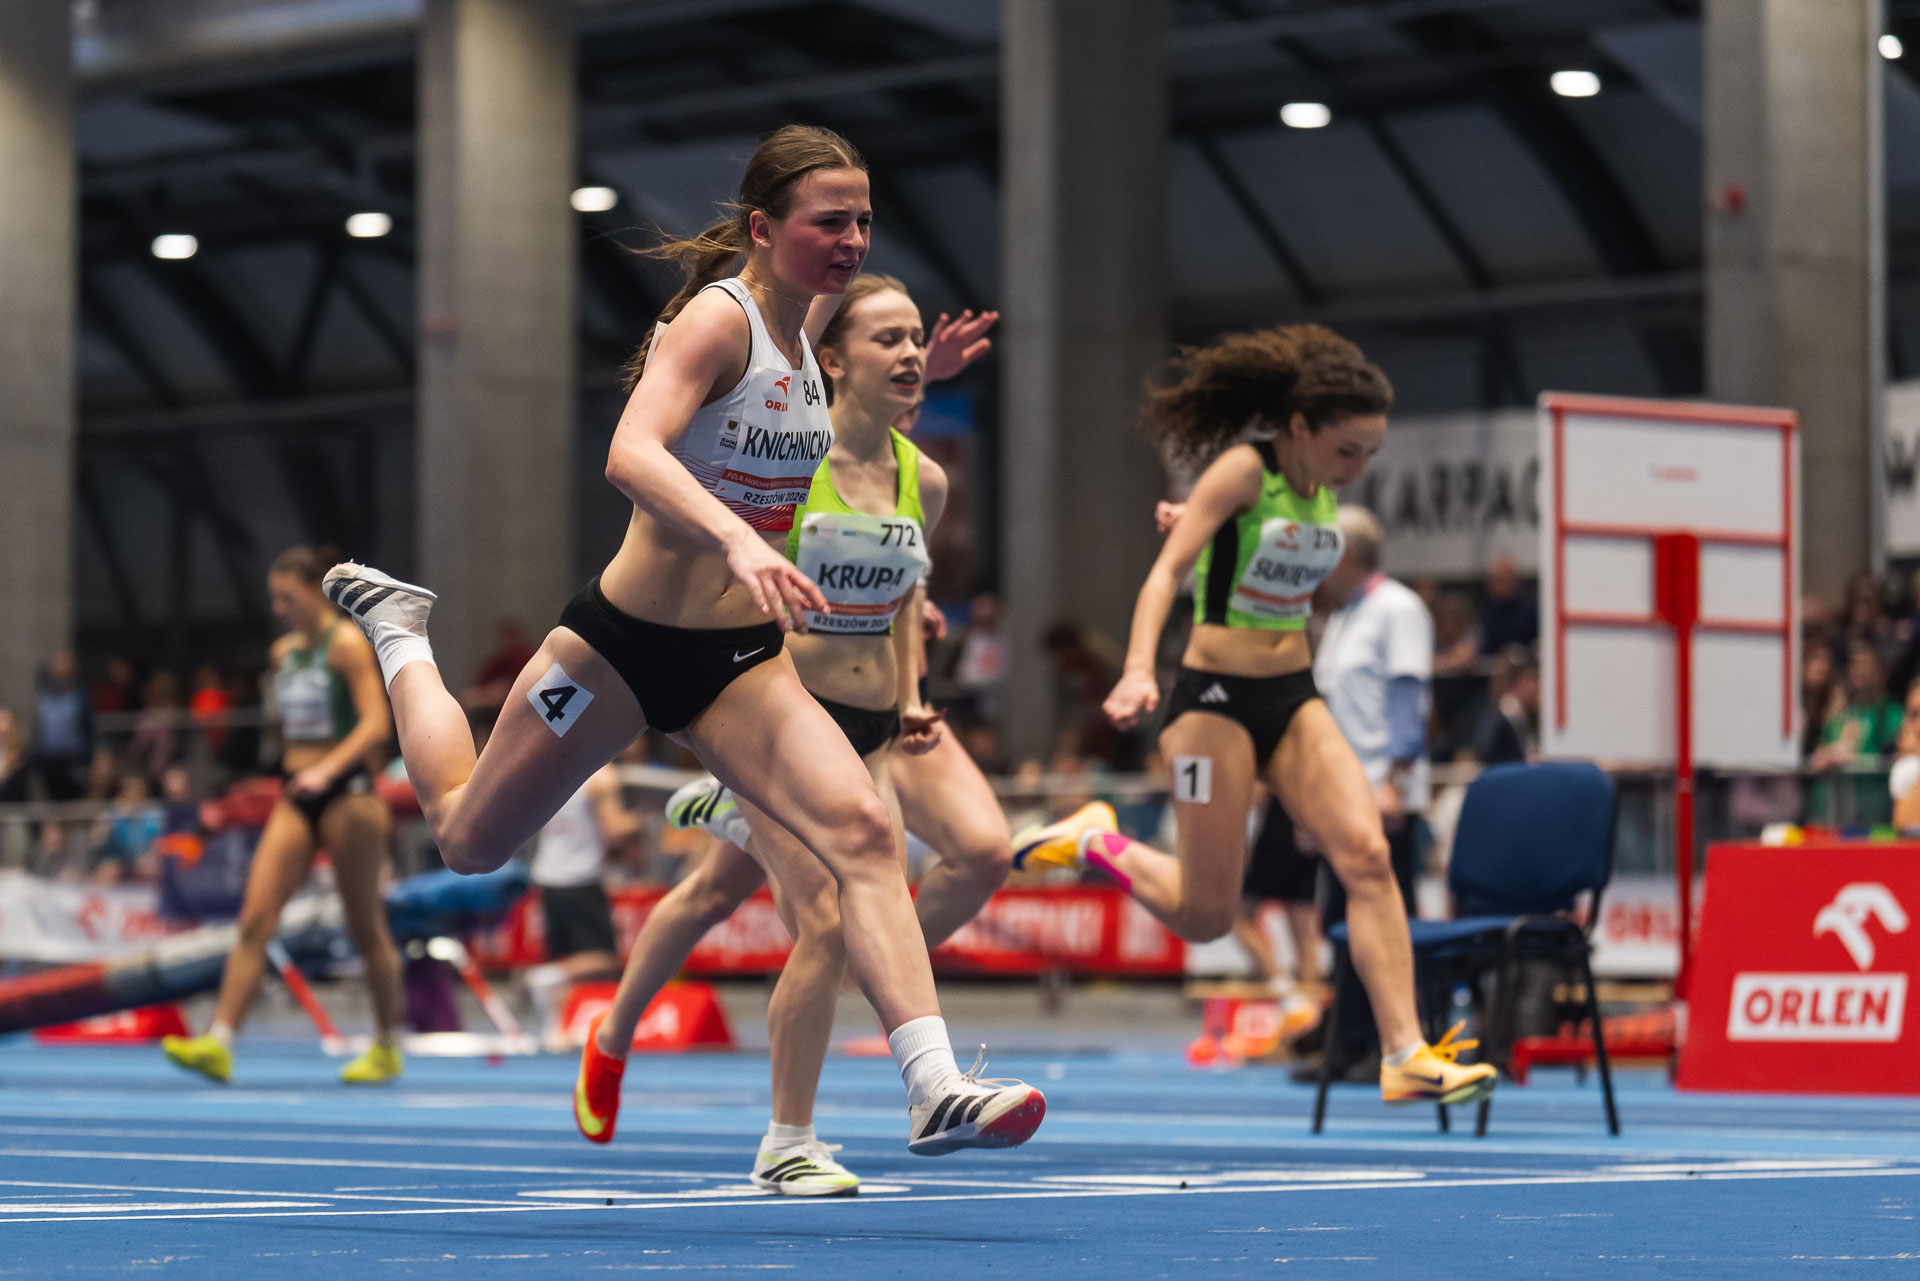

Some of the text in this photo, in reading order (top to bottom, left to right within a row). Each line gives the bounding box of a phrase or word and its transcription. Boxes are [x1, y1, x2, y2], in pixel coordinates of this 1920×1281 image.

[803, 380, 820, 406] 84
[742, 426, 831, 460] KNICHNICKA
[743, 491, 807, 505] RZESZÓW 2026
[881, 523, 916, 547] 772
[818, 563, 905, 591] KRUPA
[539, 685, 578, 723] 4
[1184, 762, 1198, 798] 1
[1745, 988, 1891, 1026] ORLEN
